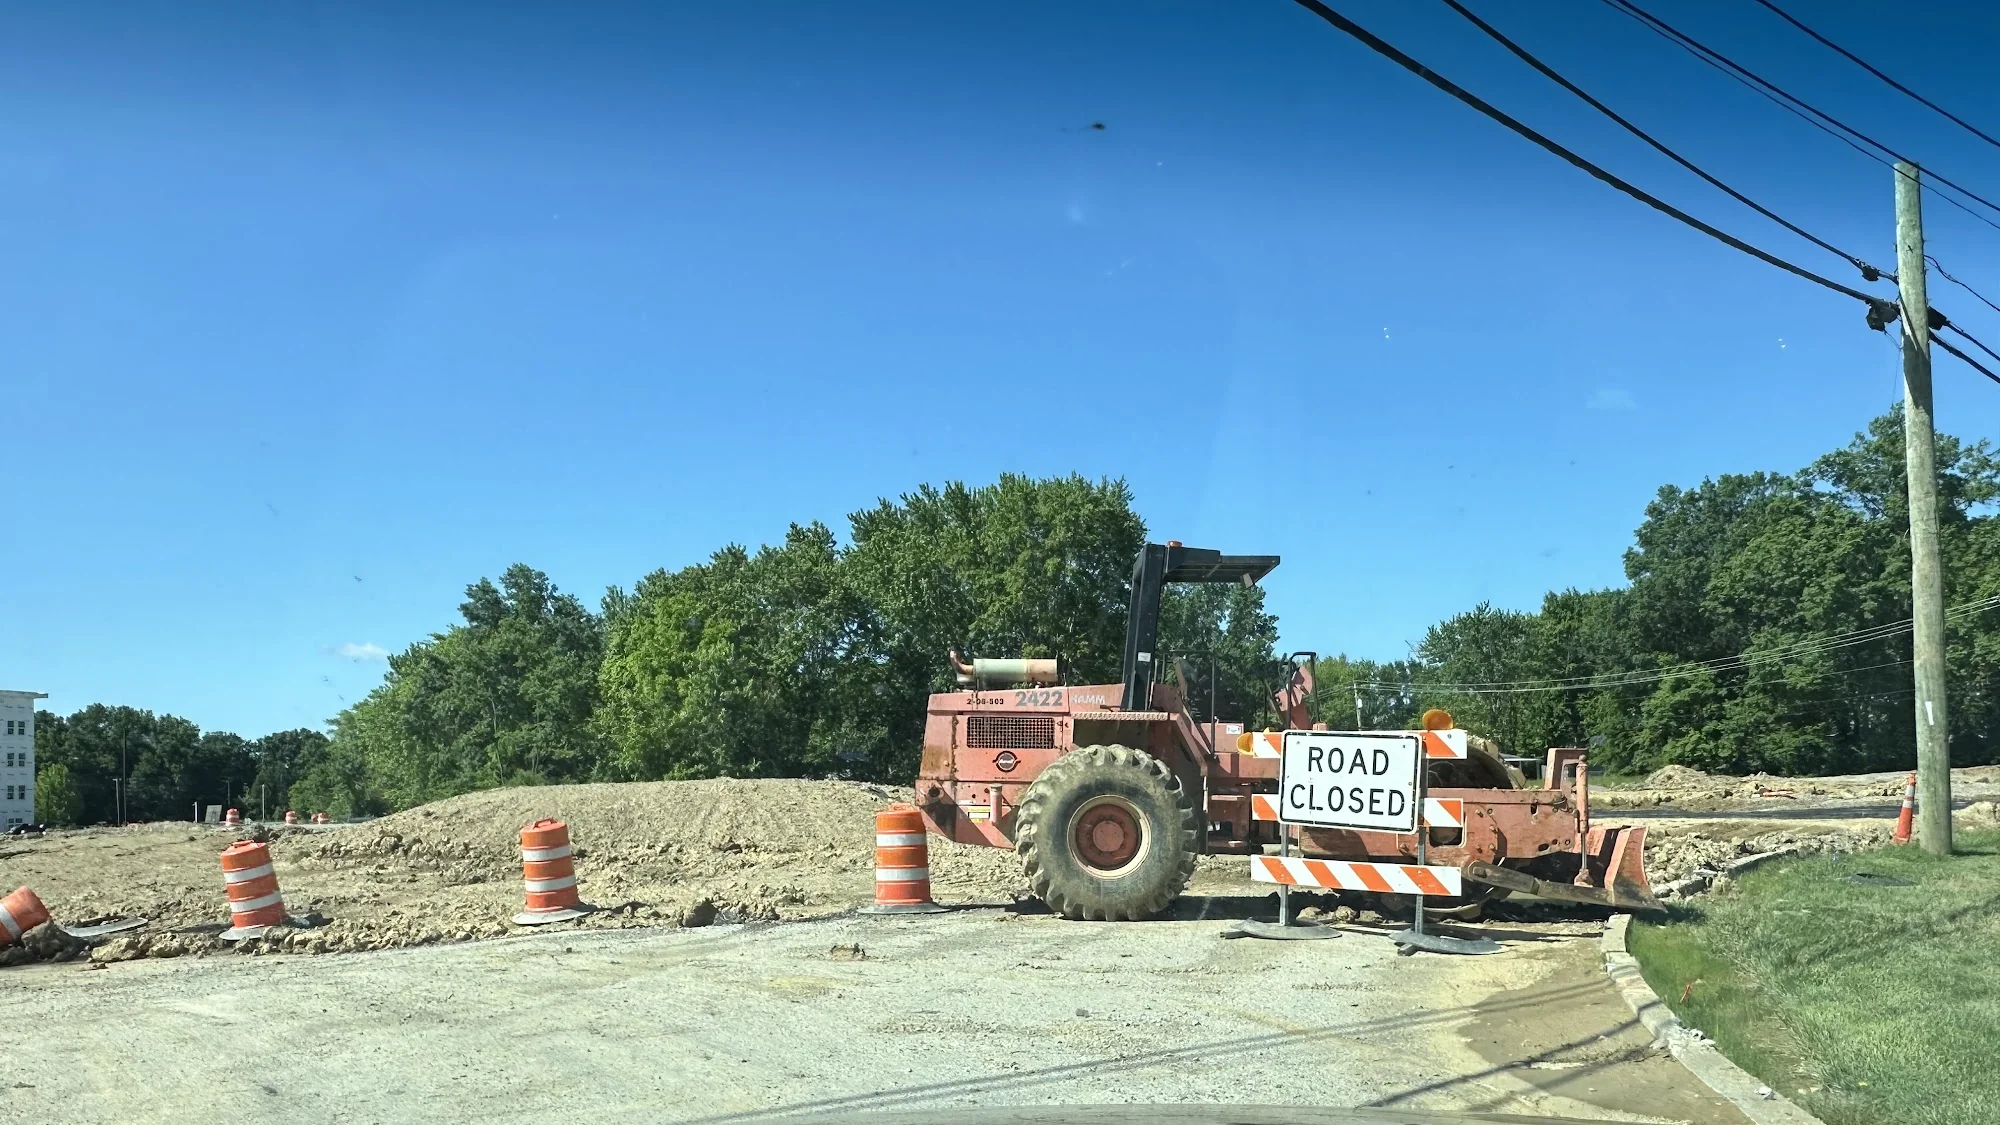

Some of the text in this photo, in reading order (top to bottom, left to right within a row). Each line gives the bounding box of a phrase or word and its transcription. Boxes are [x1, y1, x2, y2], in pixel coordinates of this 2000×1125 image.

[1015, 690, 1063, 706] 2422
[1308, 746, 1389, 775] ROAD
[1290, 784, 1405, 816] CLOSED
